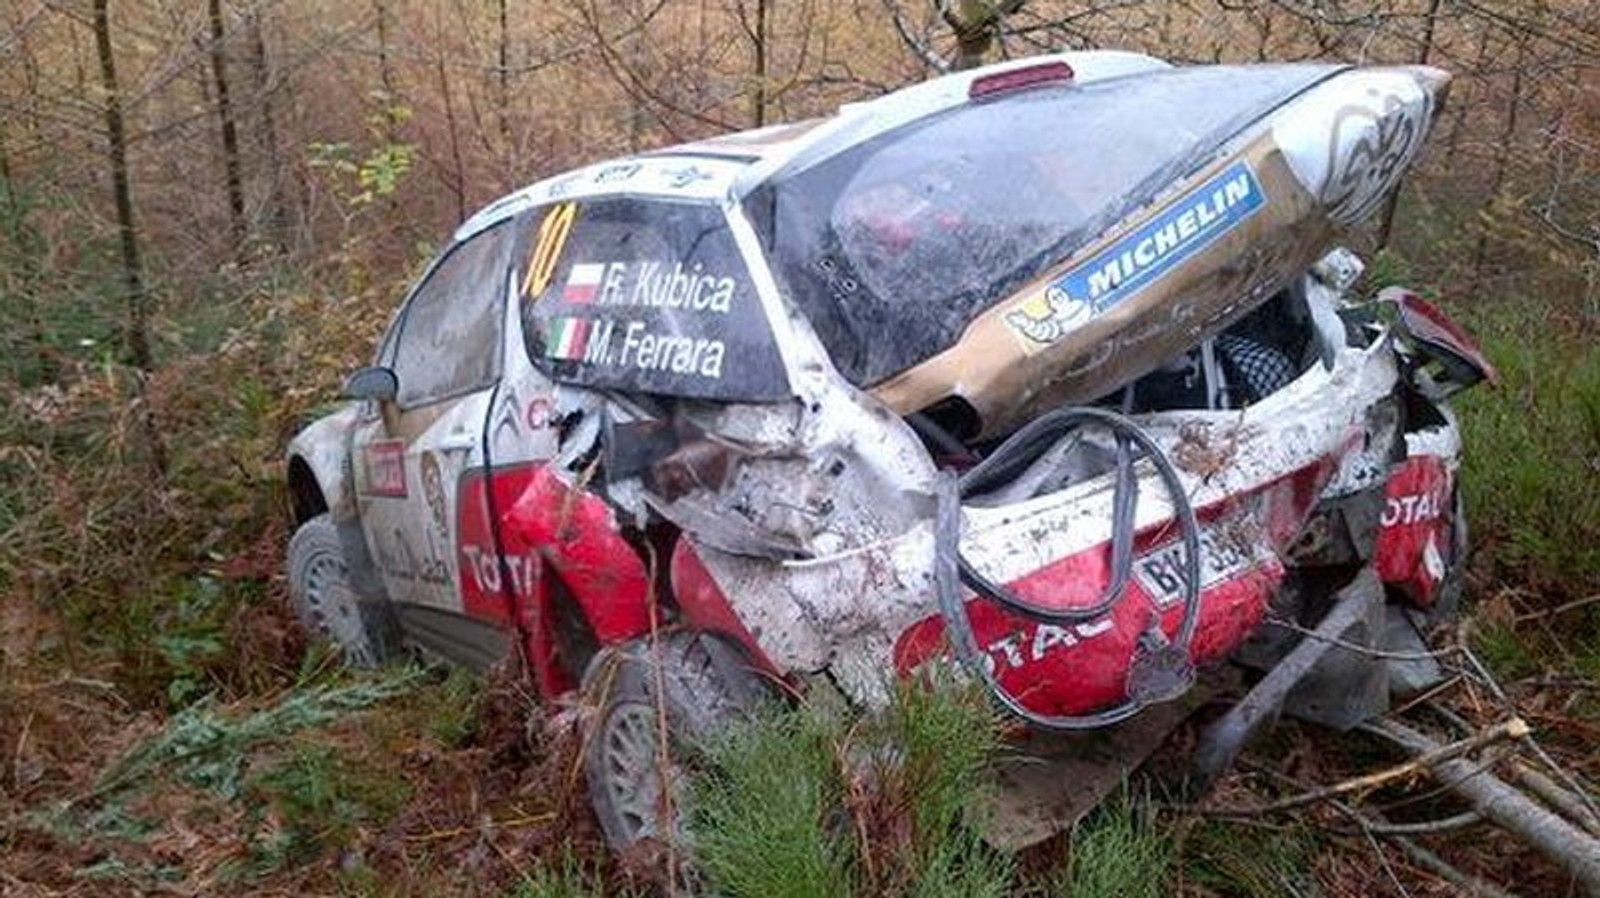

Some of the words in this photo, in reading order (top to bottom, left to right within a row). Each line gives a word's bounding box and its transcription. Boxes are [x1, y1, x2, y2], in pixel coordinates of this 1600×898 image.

[1088, 173, 1251, 298] MICHELIN
[599, 261, 627, 305] R.
[632, 261, 736, 313] Kubica
[583, 318, 615, 367] M.
[620, 321, 726, 379] Ferrara
[1380, 492, 1440, 529] OTAL
